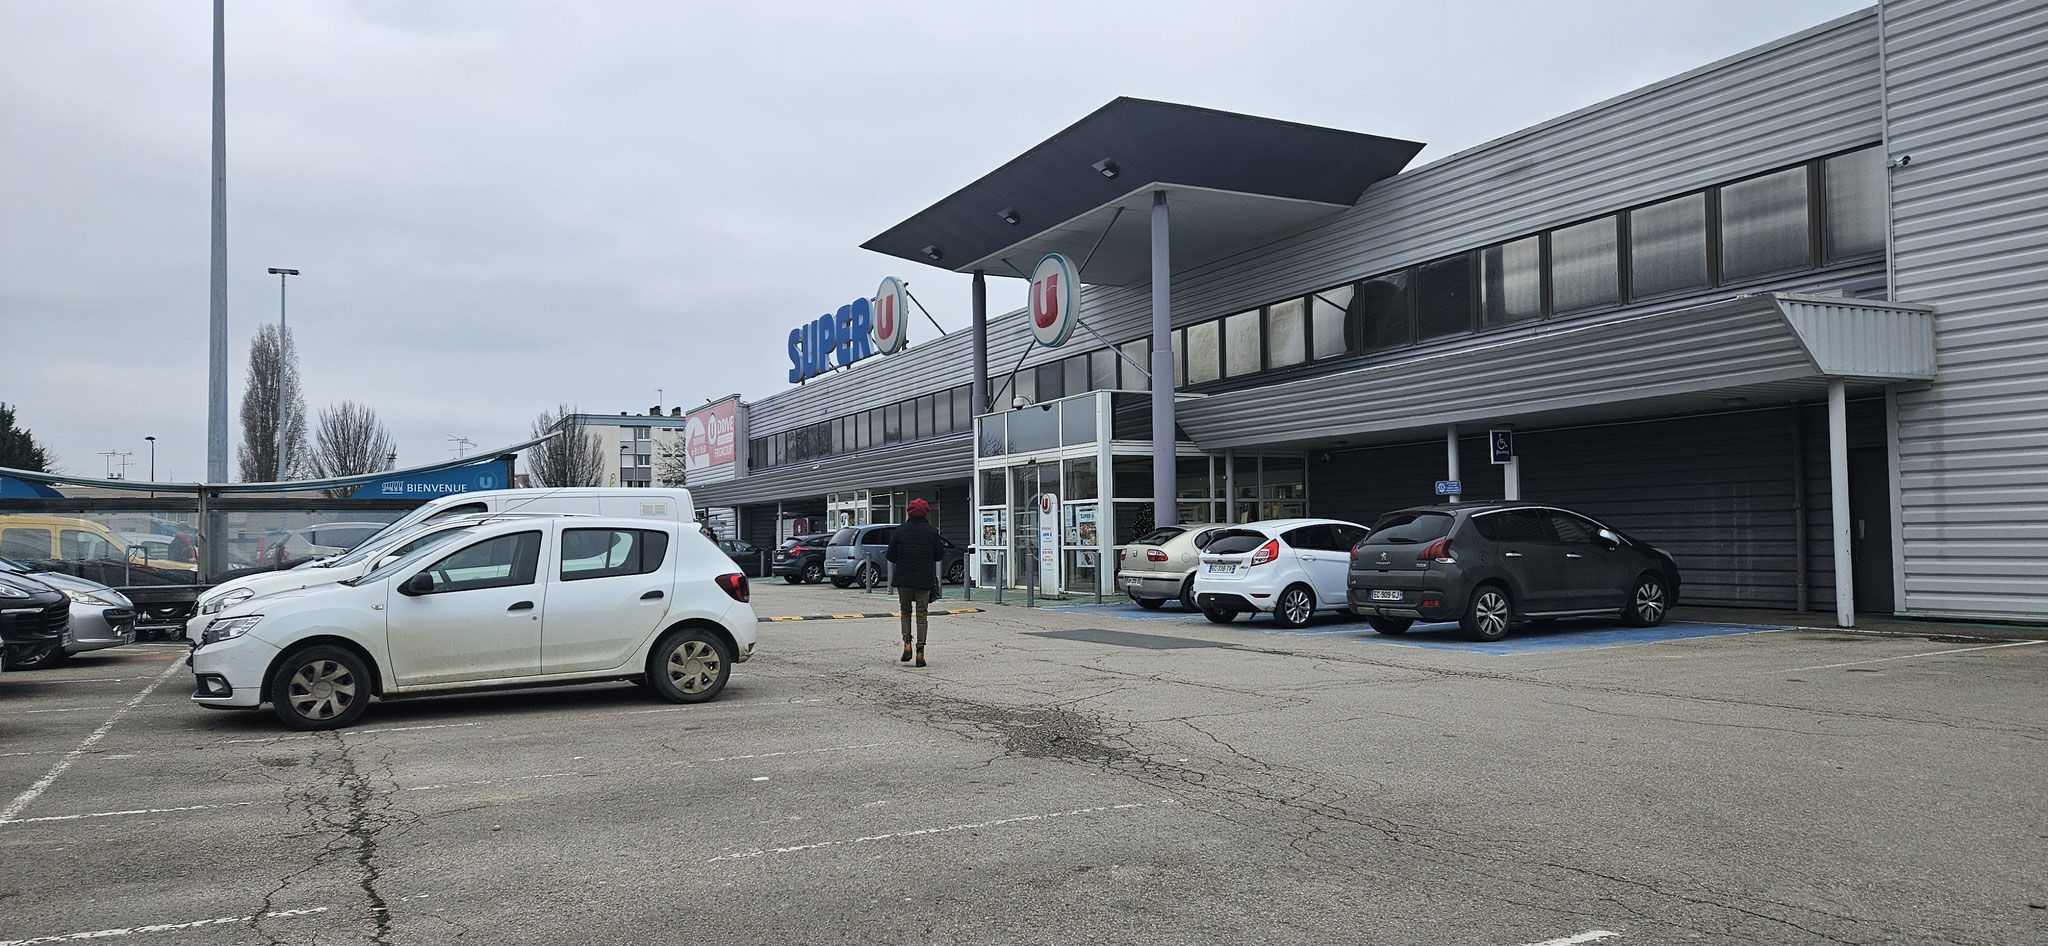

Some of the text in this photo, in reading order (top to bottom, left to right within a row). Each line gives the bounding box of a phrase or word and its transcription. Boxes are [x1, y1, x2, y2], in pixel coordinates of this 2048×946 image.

[1033, 273, 1058, 329] U
[788, 294, 894, 383] SUPER U
[717, 415, 735, 434] DRIVE
[407, 483, 467, 493] BIENVENUE
[479, 476, 493, 489] U
[1042, 498, 1049, 510] U
